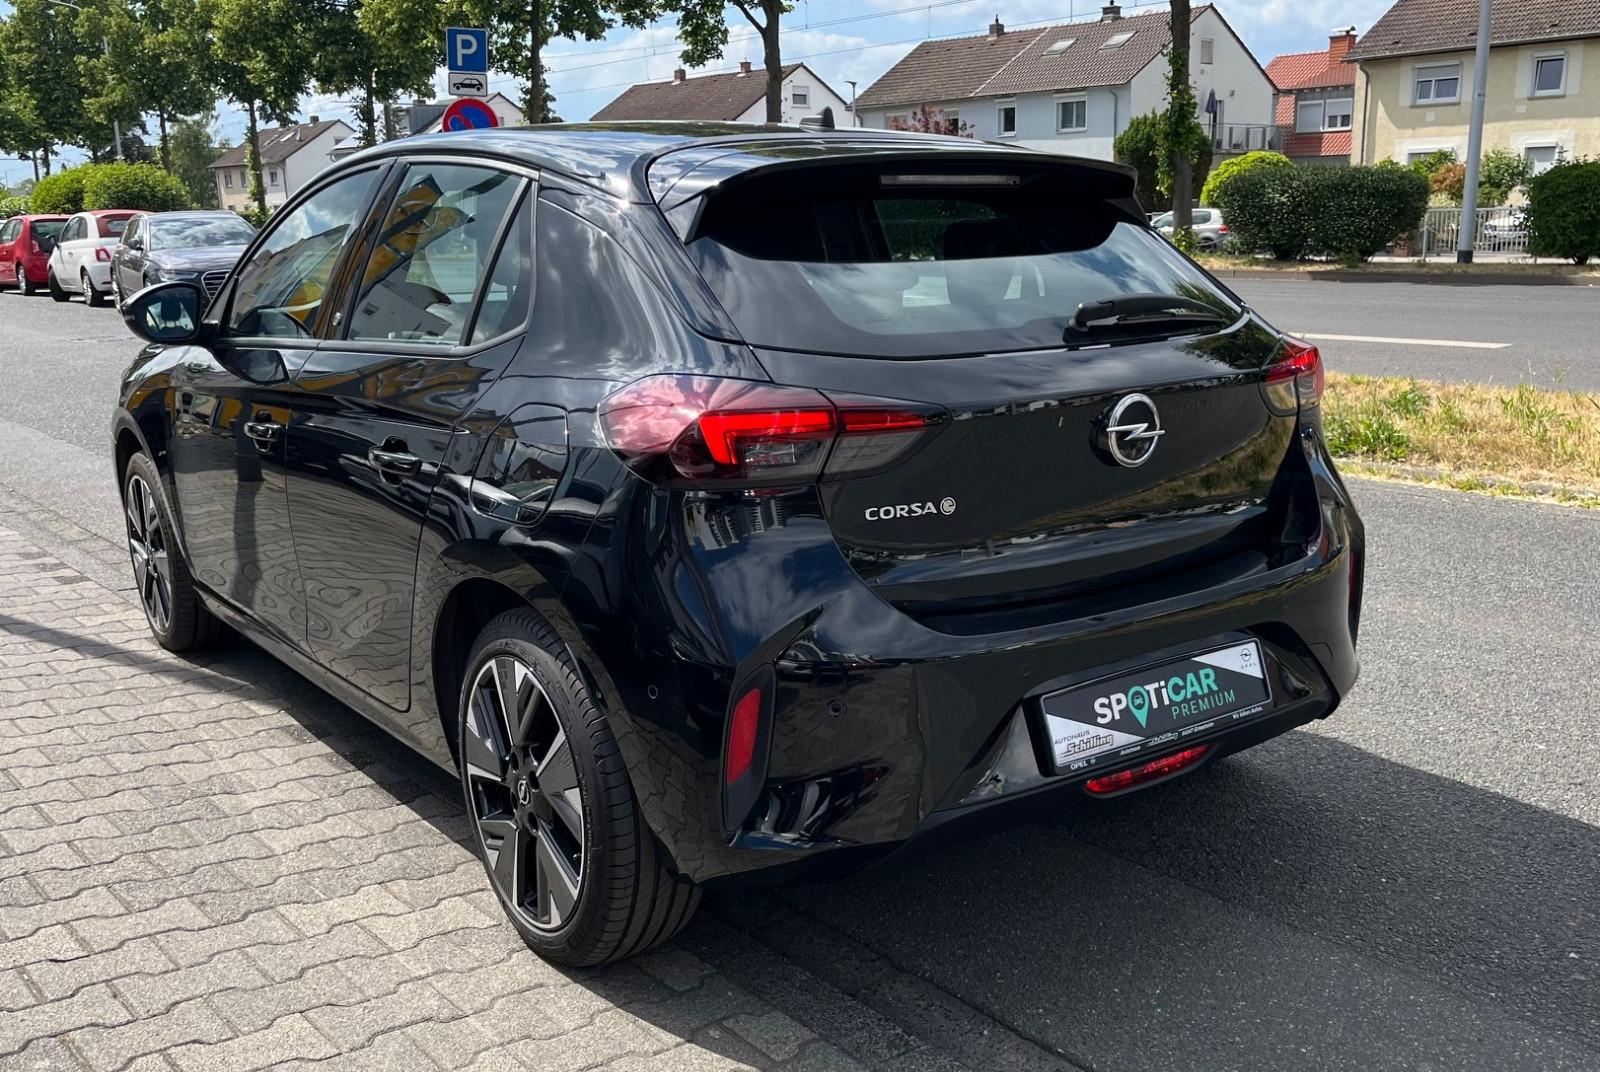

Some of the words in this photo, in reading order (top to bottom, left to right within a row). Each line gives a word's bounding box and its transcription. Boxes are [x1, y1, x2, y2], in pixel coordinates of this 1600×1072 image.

[456, 34, 477, 66] P
[865, 502, 938, 521] CORSA
[1171, 688, 1236, 720] PREMIUM
[1054, 729, 1090, 745] AUTOHAUS
[1064, 733, 1115, 756] Schilling
